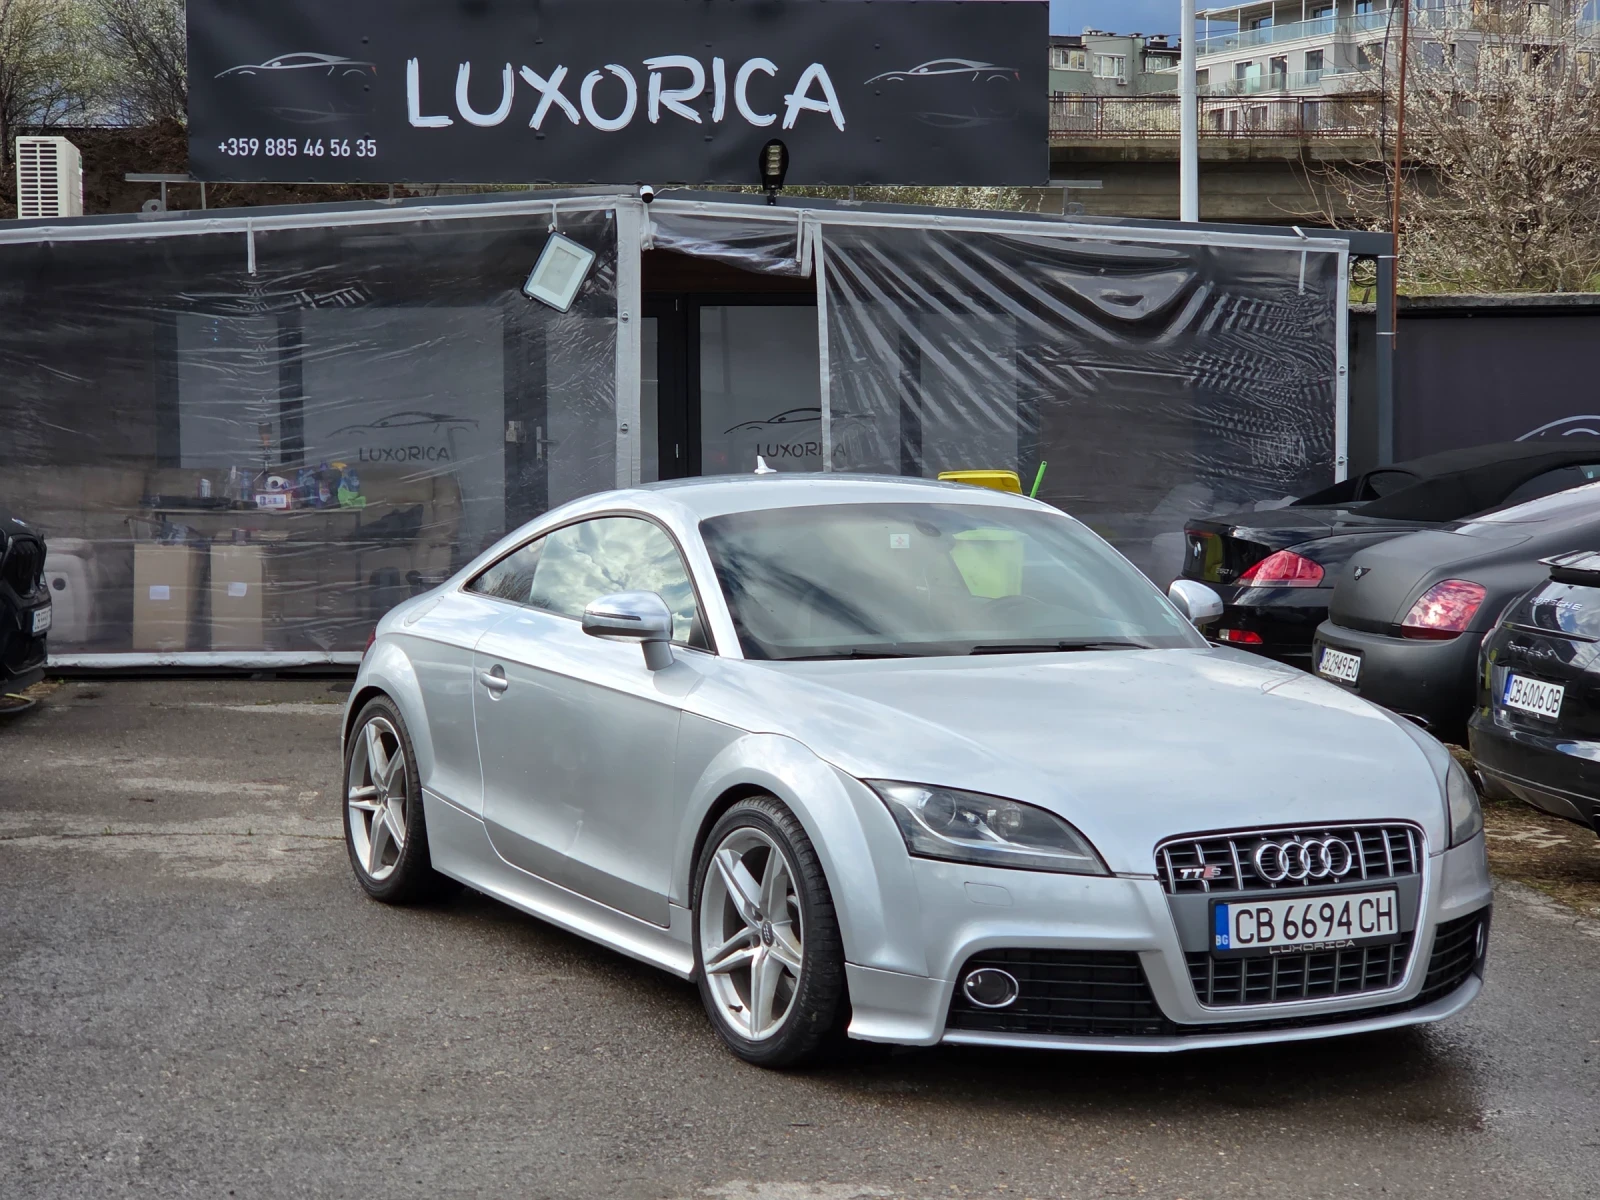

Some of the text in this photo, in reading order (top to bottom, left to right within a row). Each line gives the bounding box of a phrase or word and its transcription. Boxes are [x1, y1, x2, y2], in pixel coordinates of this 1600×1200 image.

[406, 55, 845, 131] LUXORICA
[218, 138, 377, 157] +359 885 46 56 35
[359, 446, 449, 462] LUXORICA
[756, 442, 846, 458] LUXORIA
[1509, 679, 1523, 703] CB
[1522, 682, 1546, 709] 6006
[1180, 867, 1221, 879] TTS
[1235, 897, 1393, 944] CB 6694 CH
[1216, 934, 1228, 946] BG
[1269, 939, 1355, 954] LUXORICA
